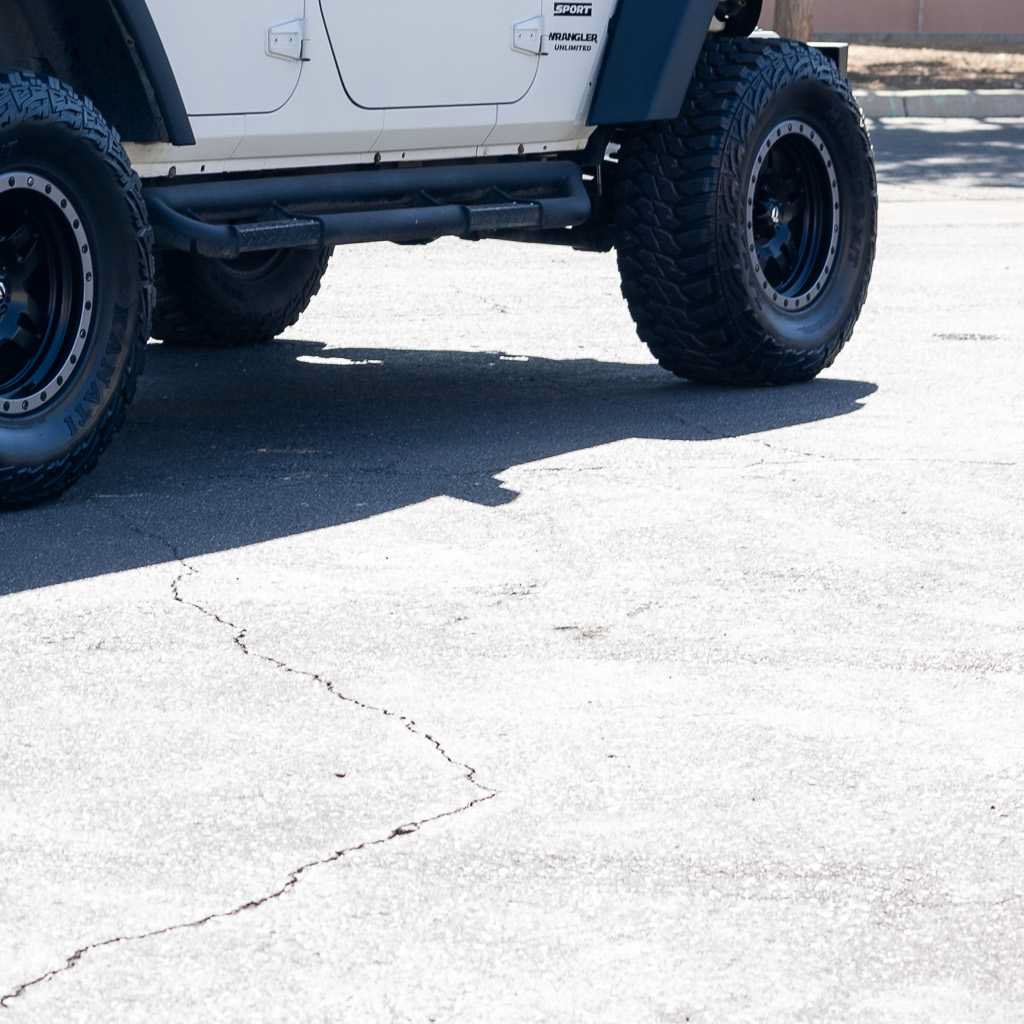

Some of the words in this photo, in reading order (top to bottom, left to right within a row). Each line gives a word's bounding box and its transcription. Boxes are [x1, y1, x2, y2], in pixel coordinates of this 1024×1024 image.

[554, 4, 591, 15] SPORT
[548, 32, 598, 43] WRANGLER
[554, 44, 592, 52] UNLIMITED
